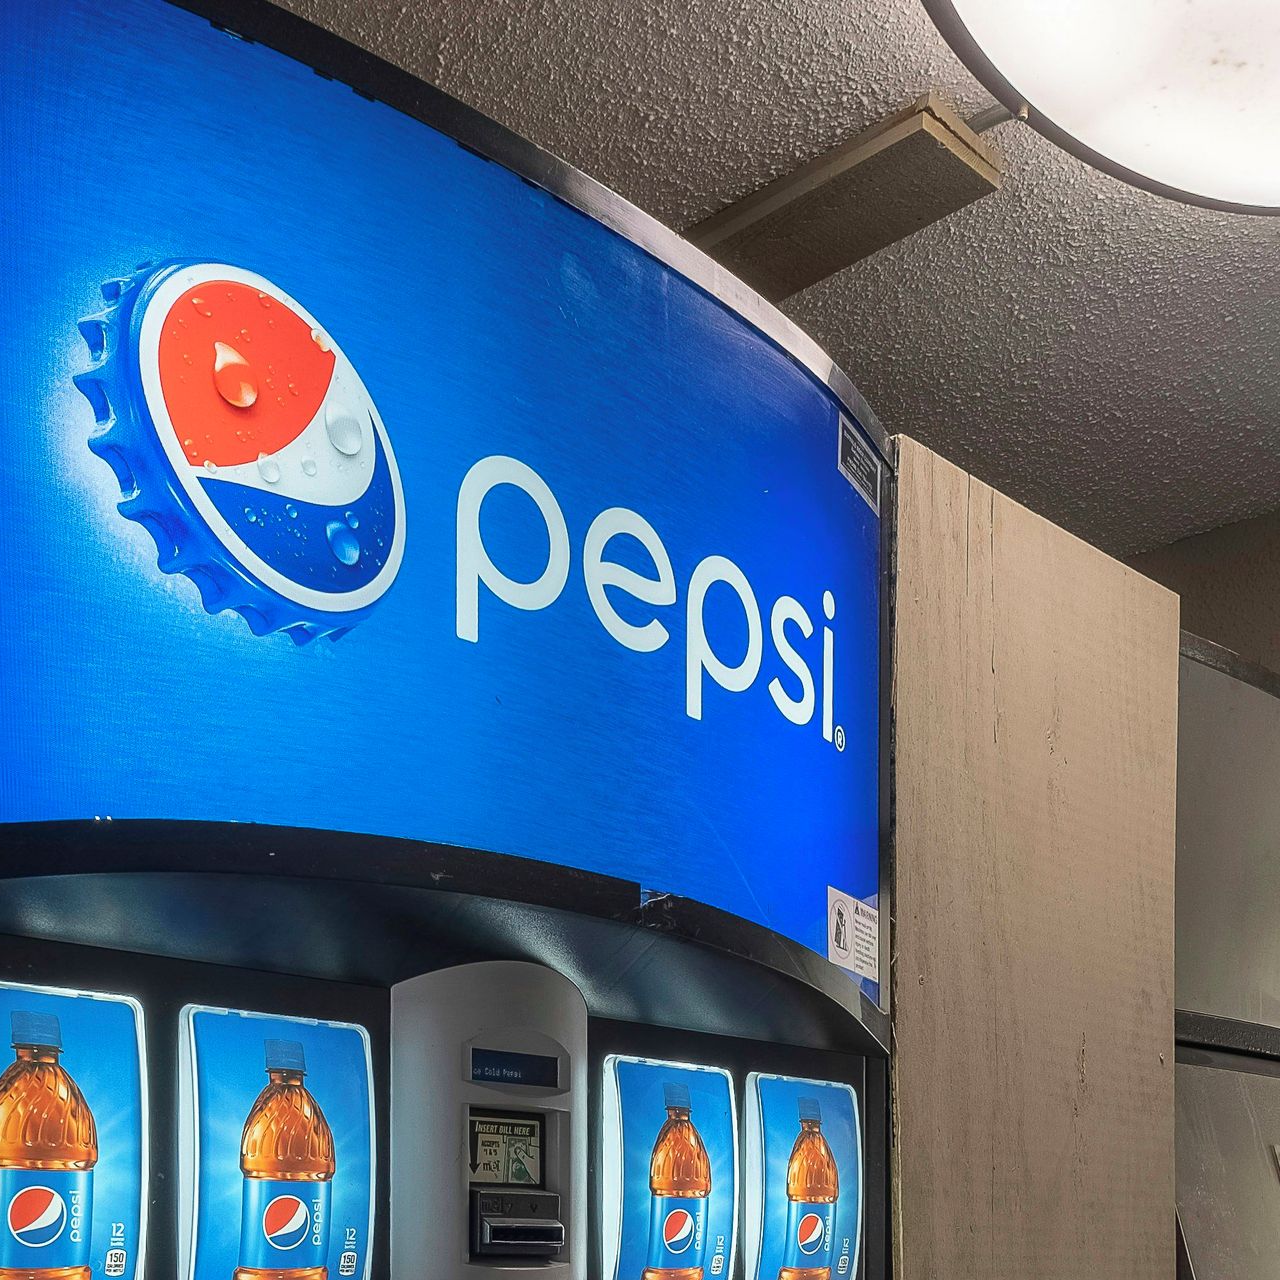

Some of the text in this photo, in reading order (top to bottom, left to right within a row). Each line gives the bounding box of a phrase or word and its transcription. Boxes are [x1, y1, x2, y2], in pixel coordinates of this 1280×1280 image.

[456, 455, 836, 744] pepsi
[475, 1121, 531, 1136] INSERT BILL HERE
[69, 1190, 83, 1242] pepsi
[312, 1199, 323, 1246] pepsi
[111, 1222, 125, 1237] 12
[345, 1228, 356, 1241] 12
[716, 1235, 725, 1246] 12
[109, 1252, 124, 1263] 150
[342, 1254, 356, 1264] 150
